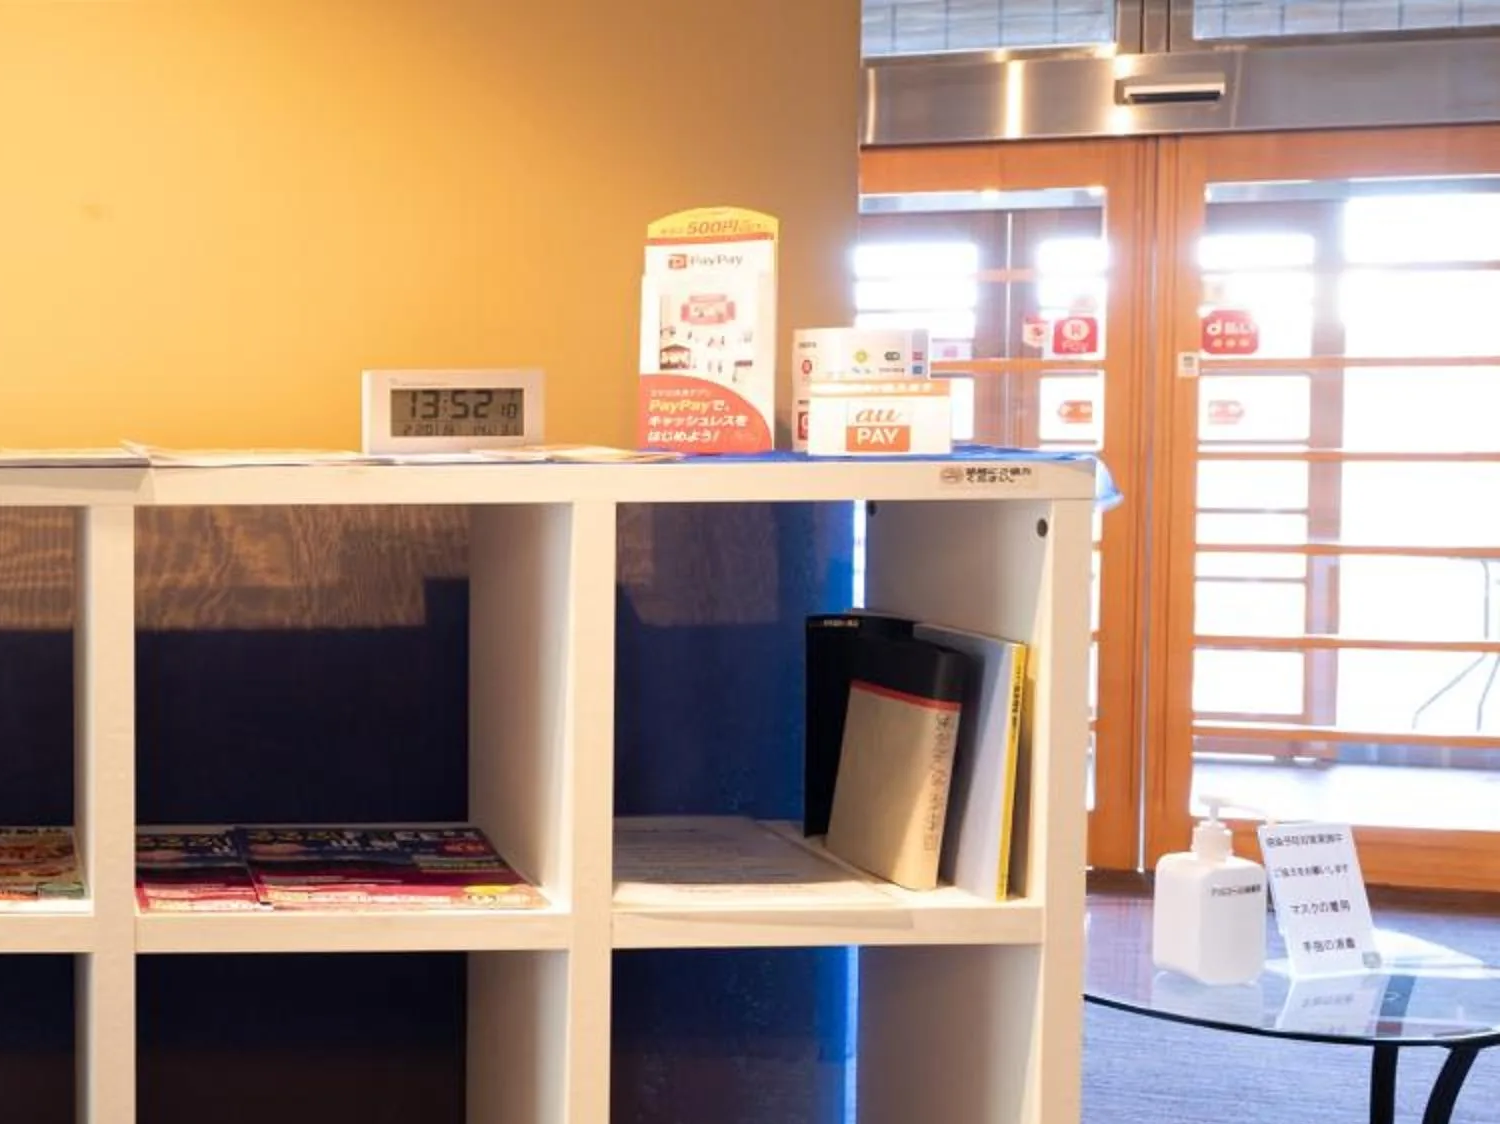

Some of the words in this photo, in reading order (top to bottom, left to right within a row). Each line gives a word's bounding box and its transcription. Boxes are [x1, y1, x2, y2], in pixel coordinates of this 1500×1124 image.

[690, 253, 744, 268] PayPay
[410, 390, 493, 419] 13:52
[857, 427, 900, 445] PAY
